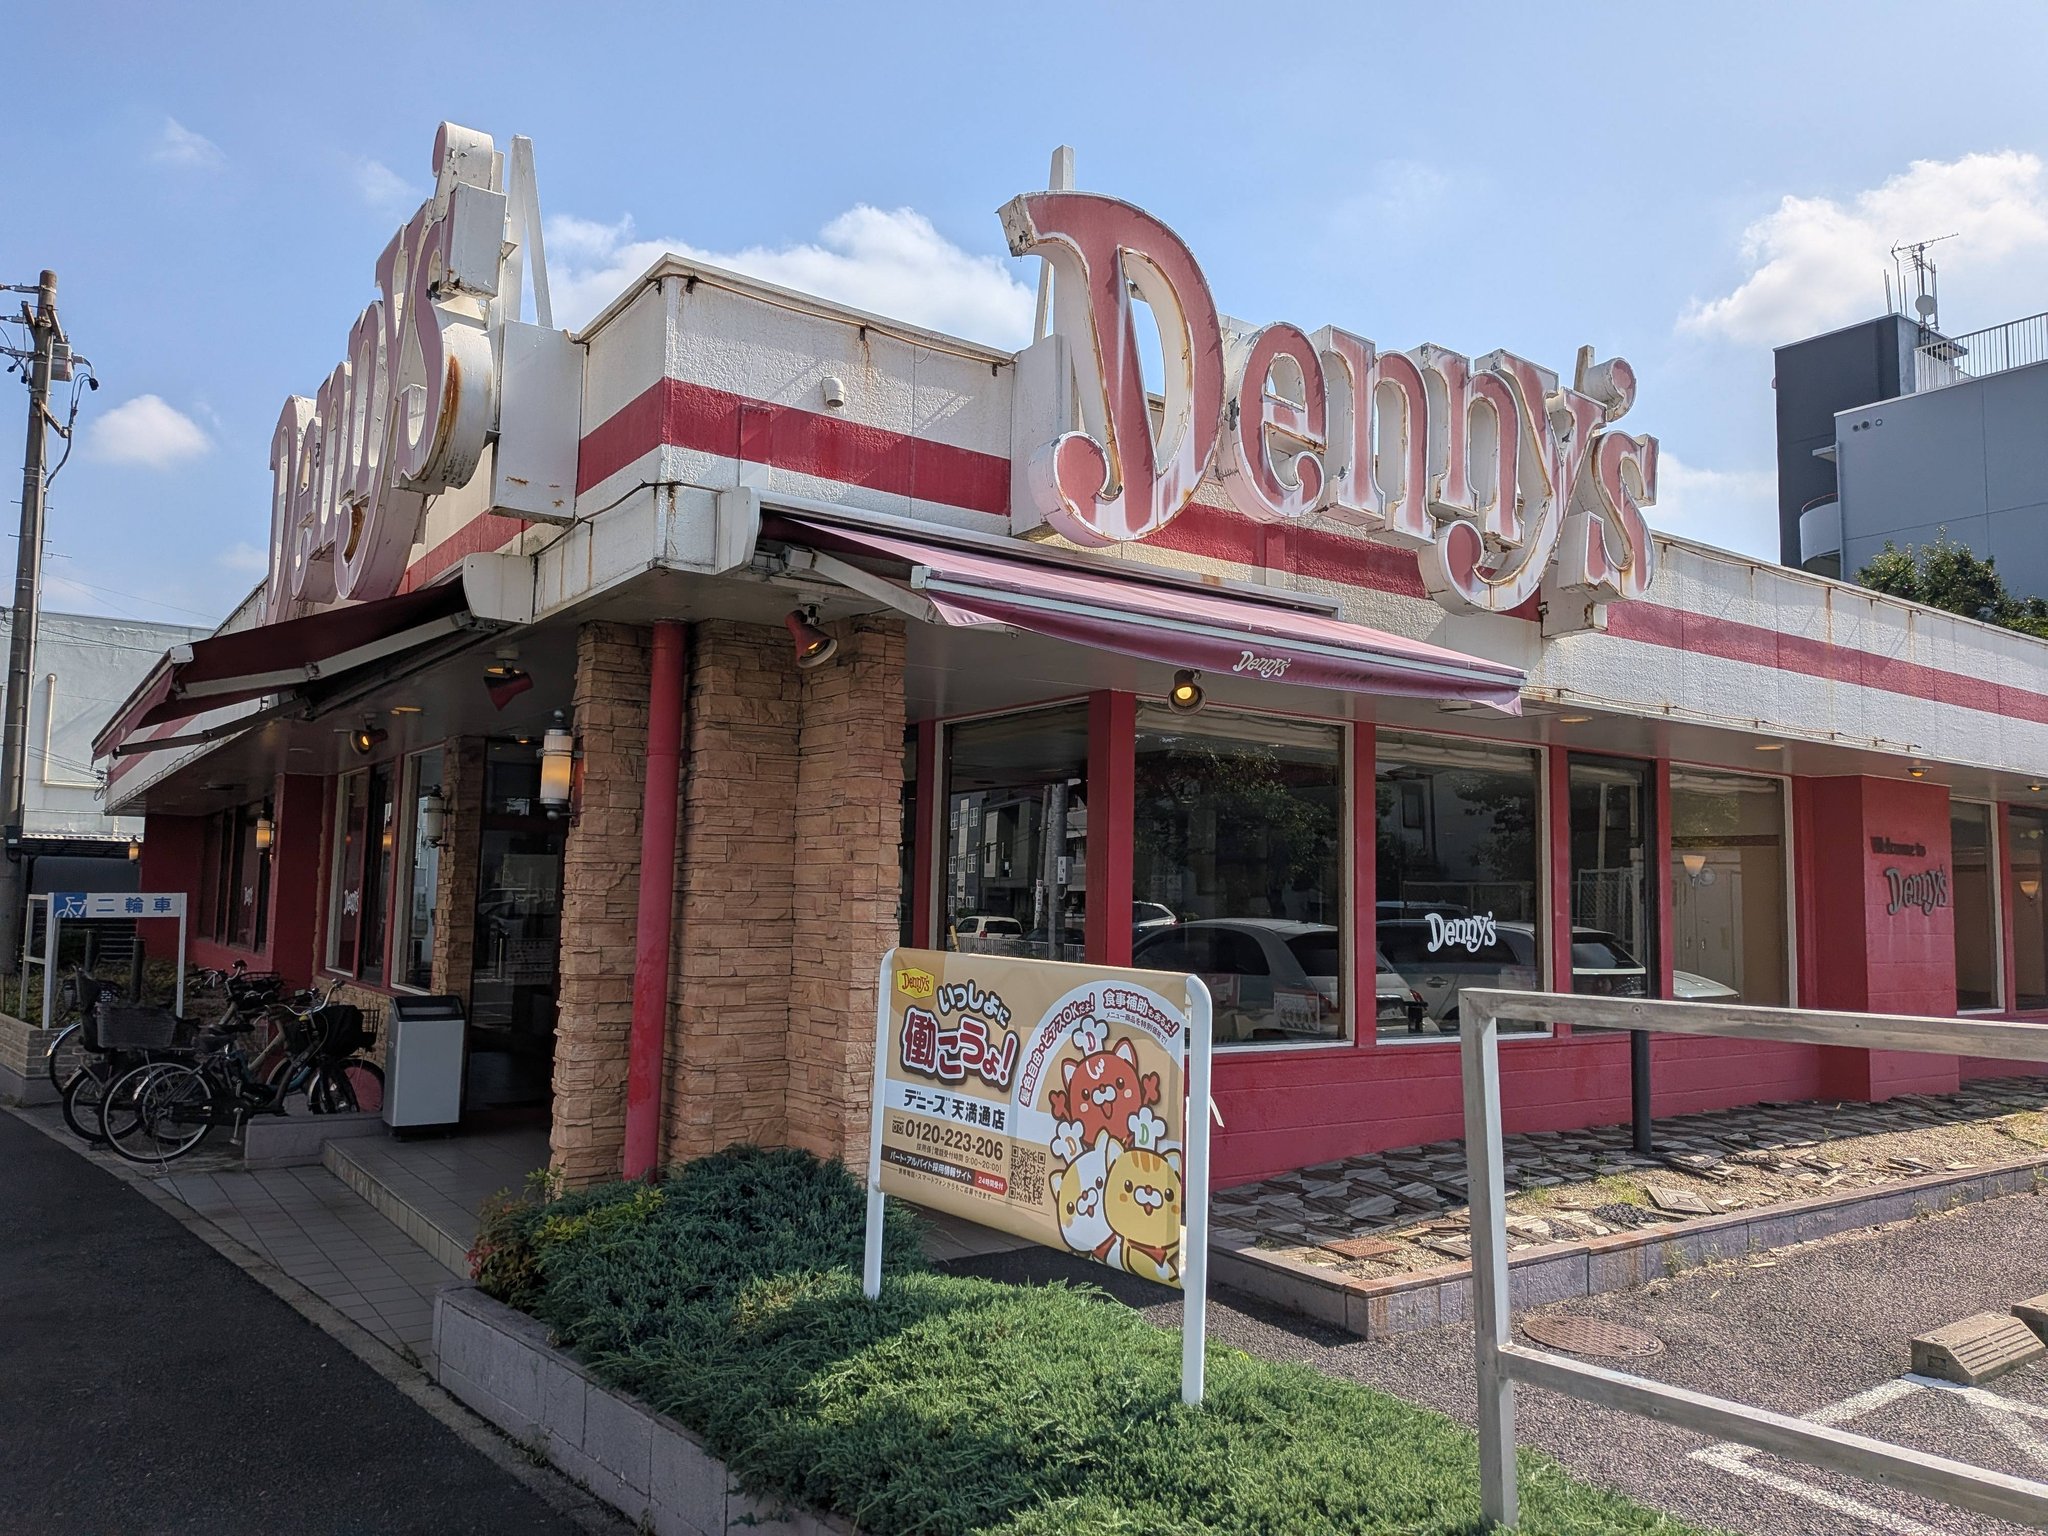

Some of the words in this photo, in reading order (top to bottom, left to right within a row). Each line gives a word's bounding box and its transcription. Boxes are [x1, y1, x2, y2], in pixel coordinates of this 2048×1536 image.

[996, 190, 1658, 615] Denny's
[1233, 650, 1291, 678] Denny's
[96, 896, 173, 914] 二輪車
[1883, 864, 1948, 916] Denny's
[1424, 911, 1497, 953] Denny's
[901, 972, 931, 994] Denny's
[938, 981, 1010, 1028] いっしょに
[1103, 989, 1179, 1037] 食事補助もあるよ!
[904, 1088, 950, 1116] デニーズ
[951, 1099, 1006, 1131] 天満通店
[905, 1119, 1004, 1160] 0120-223-206
[978, 1176, 1004, 1191] 24時間受付
